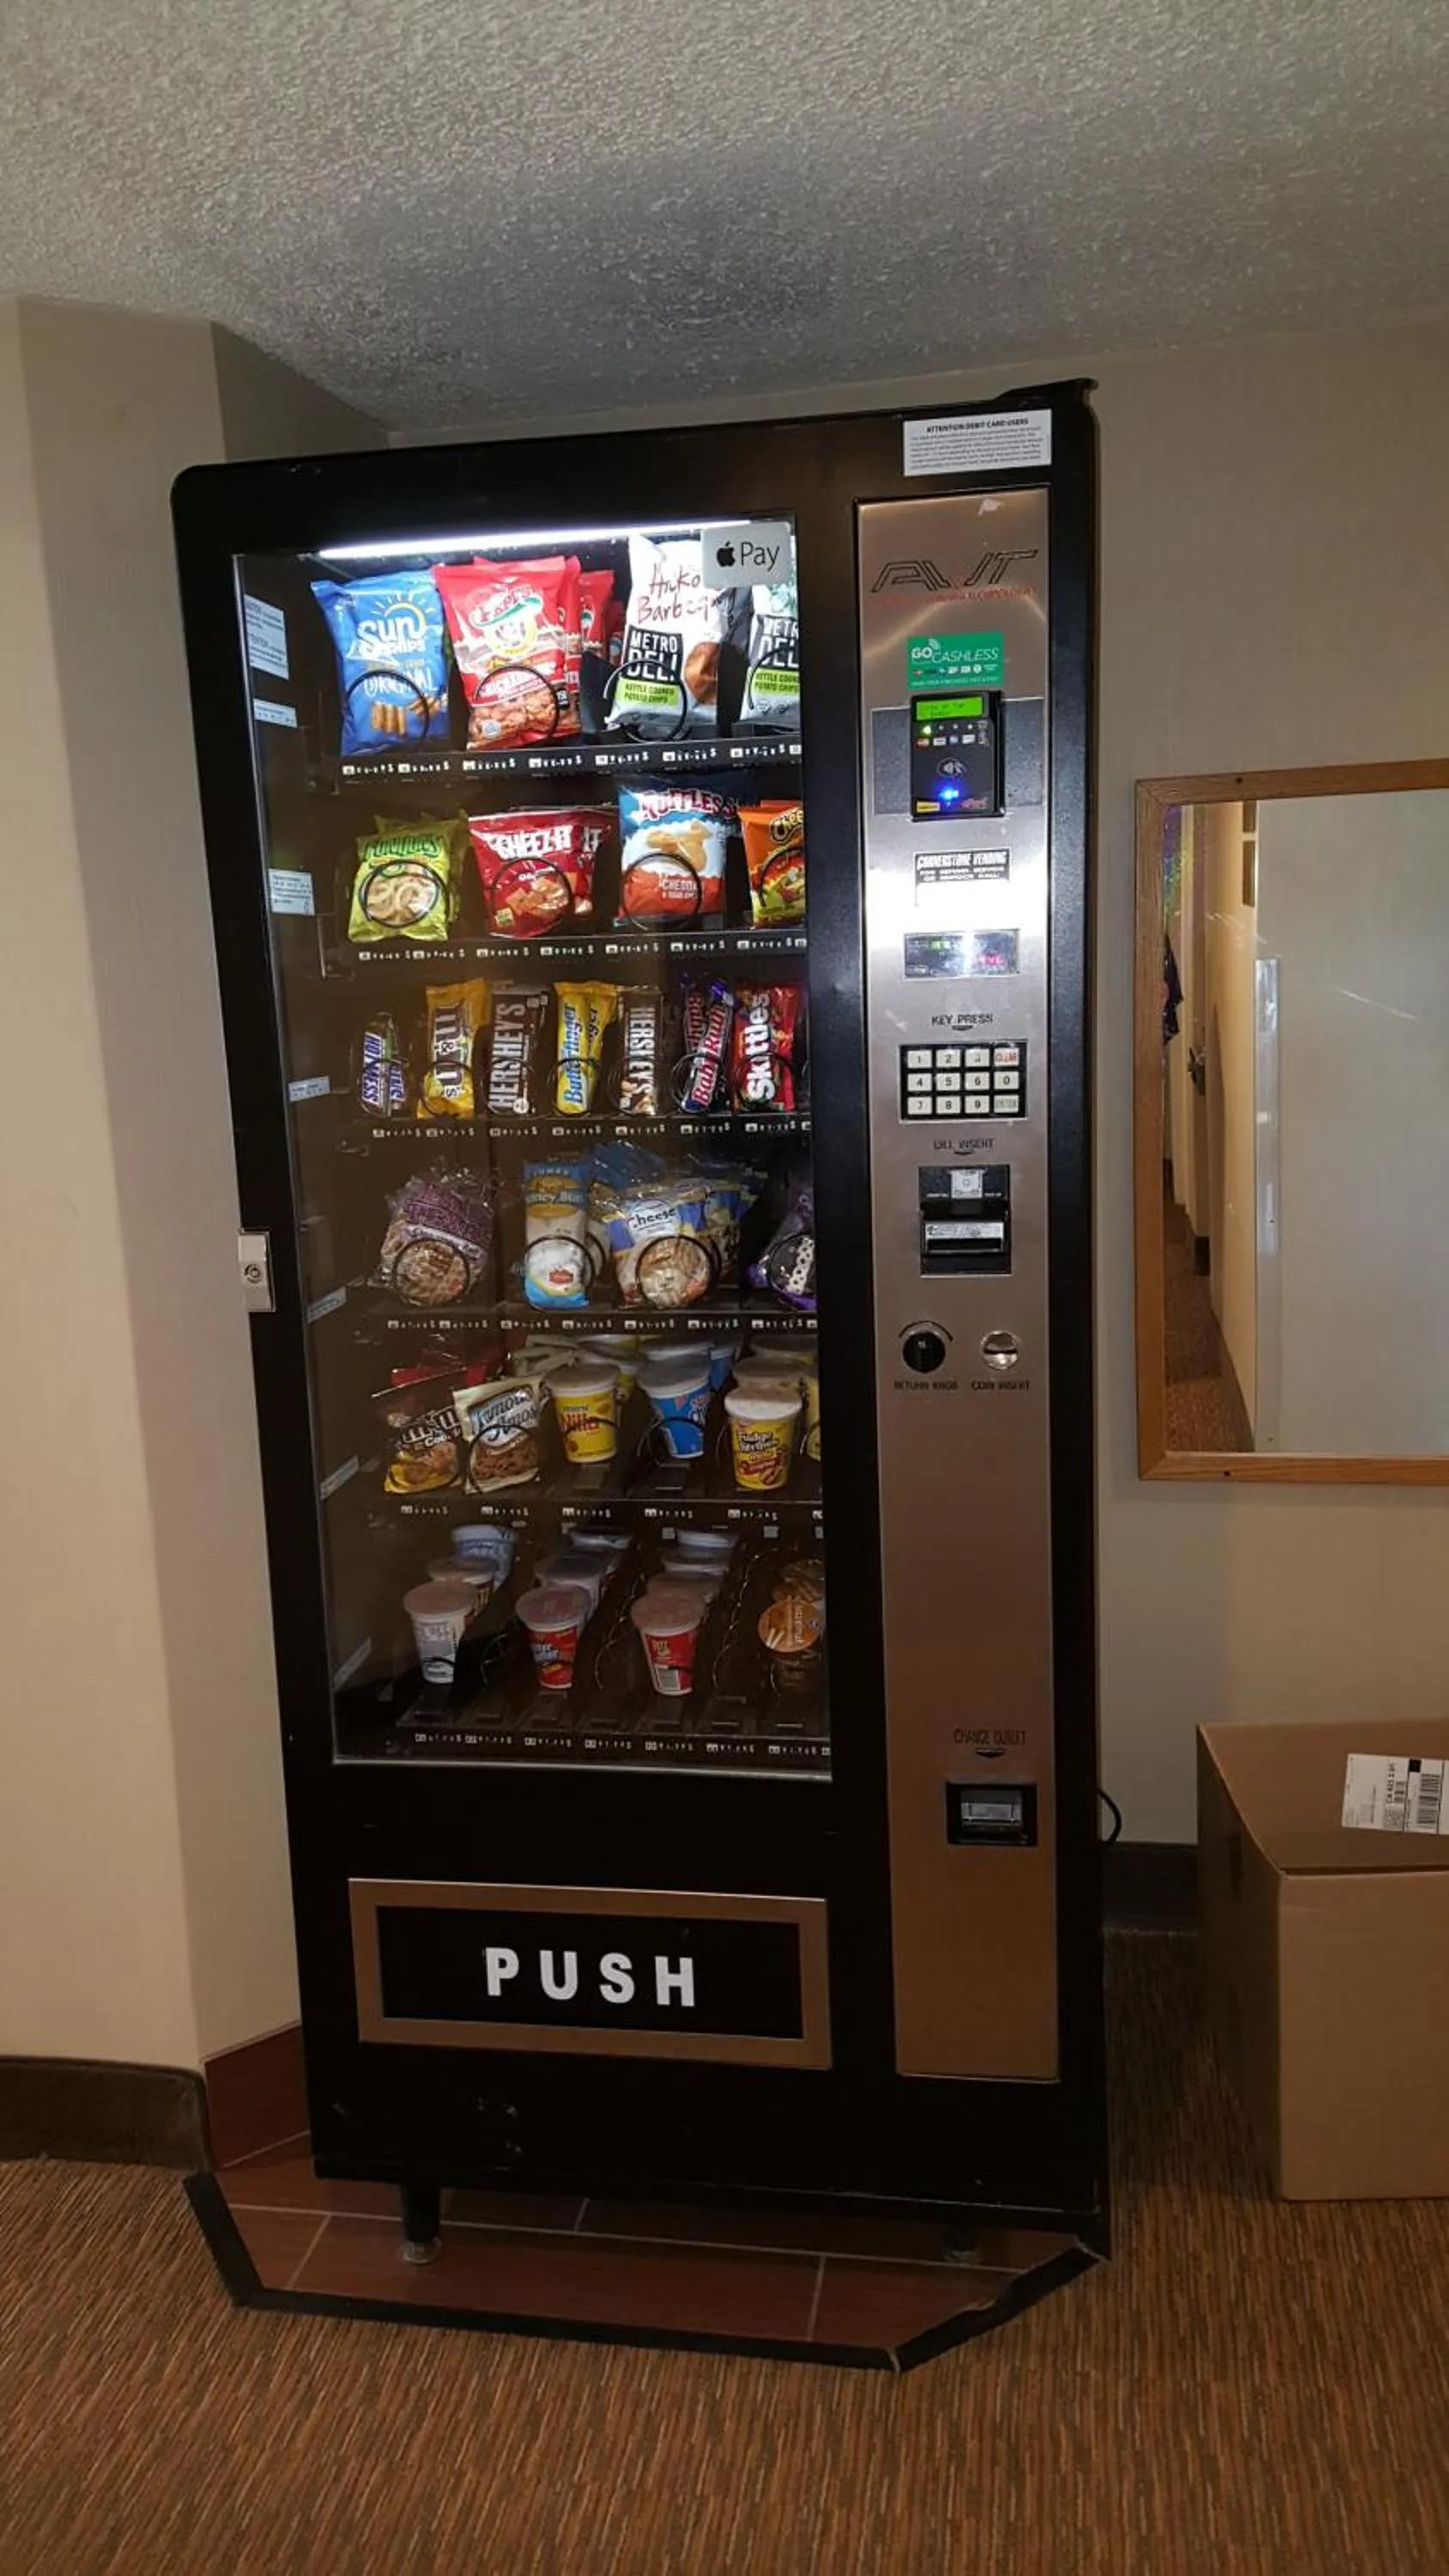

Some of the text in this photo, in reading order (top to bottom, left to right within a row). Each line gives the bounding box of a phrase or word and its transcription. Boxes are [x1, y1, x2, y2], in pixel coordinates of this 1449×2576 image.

[740, 541, 781, 572] Pay
[356, 615, 427, 647] Sun
[630, 629, 678, 653] METRO
[627, 647, 678, 682] DELI
[758, 635, 799, 669] DEL
[910, 647, 1000, 664] GO CASHLESS
[779, 674, 798, 683] COOK
[769, 805, 804, 842] Chee
[931, 1013, 994, 1026] KEY PRESS
[488, 1001, 527, 1109] HERSHEY'S
[743, 991, 776, 1102] Skittles
[485, 1946, 695, 2008] PUSH
